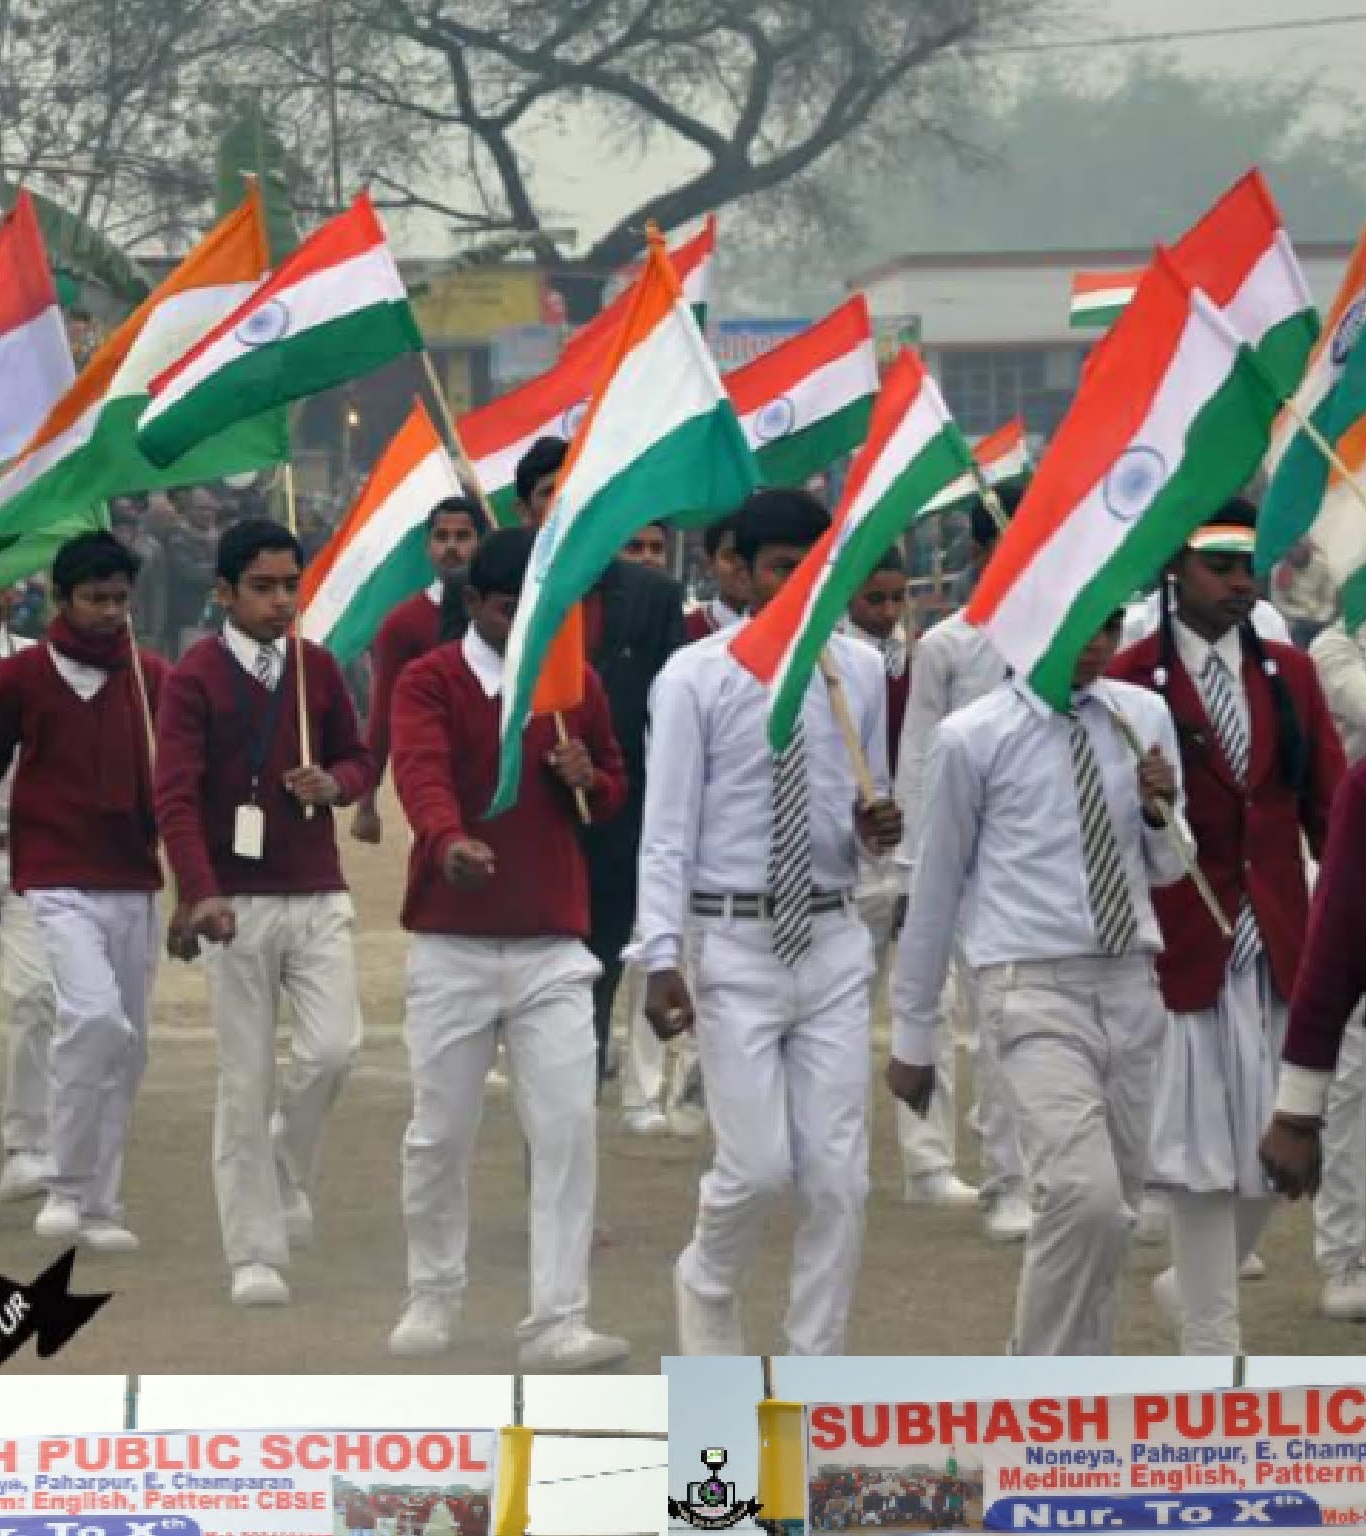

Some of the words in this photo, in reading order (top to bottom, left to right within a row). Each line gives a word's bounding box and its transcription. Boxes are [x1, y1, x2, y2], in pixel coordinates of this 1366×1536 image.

[811, 1395, 1109, 1450] SUBHASH
[1134, 1389, 1366, 1440] PUBLIC
[38, 1435, 242, 1472] PUBLIC
[260, 1433, 489, 1472] SCHOOL
[1026, 1446, 1123, 1470] Noneya,
[1131, 1443, 1247, 1466] Paharpur,
[1255, 1441, 1278, 1460] E.
[171, 1472, 295, 1492] Champaran
[999, 1466, 1121, 1490] Medium:
[1130, 1463, 1246, 1493] English,
[32, 1490, 137, 1515] English,
[145, 1490, 249, 1511] Pattern:
[257, 1490, 327, 1511] CBSE
[1013, 1503, 1124, 1529] Nur.
[1144, 1500, 1213, 1526] To
